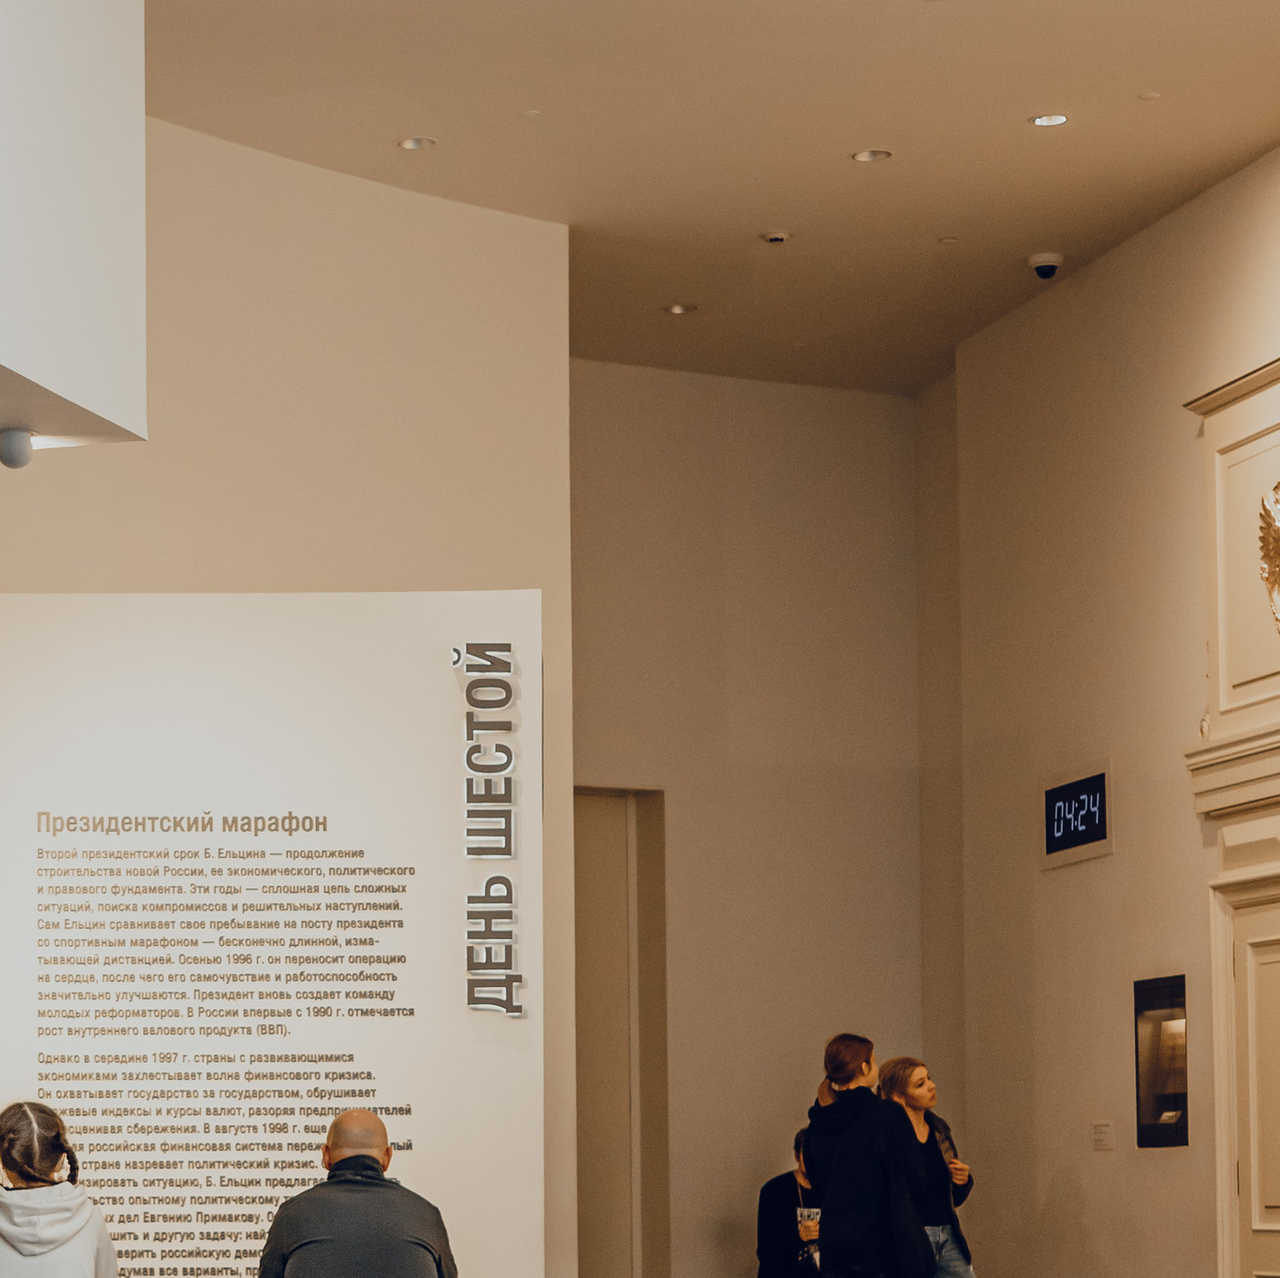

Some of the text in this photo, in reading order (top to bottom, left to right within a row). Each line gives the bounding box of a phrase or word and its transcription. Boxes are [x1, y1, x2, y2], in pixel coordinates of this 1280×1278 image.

[1054, 793, 1100, 837] 04:24
[37, 810, 327, 837] Президентский марафон
[453, 643, 523, 1014] ДЕНЬ ШЕСТОЙ
[37, 866, 416, 879] строительства новой России, ее экономического, политического
[37, 900, 403, 914] ситуаций, поиска компромиссов и решительных наступлений.
[37, 918, 404, 931] Сам Ельцин сравнивает свое пребывание на посту президента
[37, 953, 407, 967] тывающей дистанцией. Осенью 1996 г. он переносит операцию
[38, 970, 398, 985] на сердце, после чего его самочувствие и работоспособность
[38, 989, 395, 1003] значительно улучшаются. Президент вновь создает команду
[38, 1006, 415, 1020] молодых реформаторов. В России впервые с 1990 г. отмечается
[38, 1024, 291, 1039] рост внутреннего валового продукта (ВВП).
[38, 1052, 354, 1065] Однако в середине 1997 г. страны с развивающимися
[38, 1070, 376, 1083] экономиками захлестывает волна финансового кризиса.
